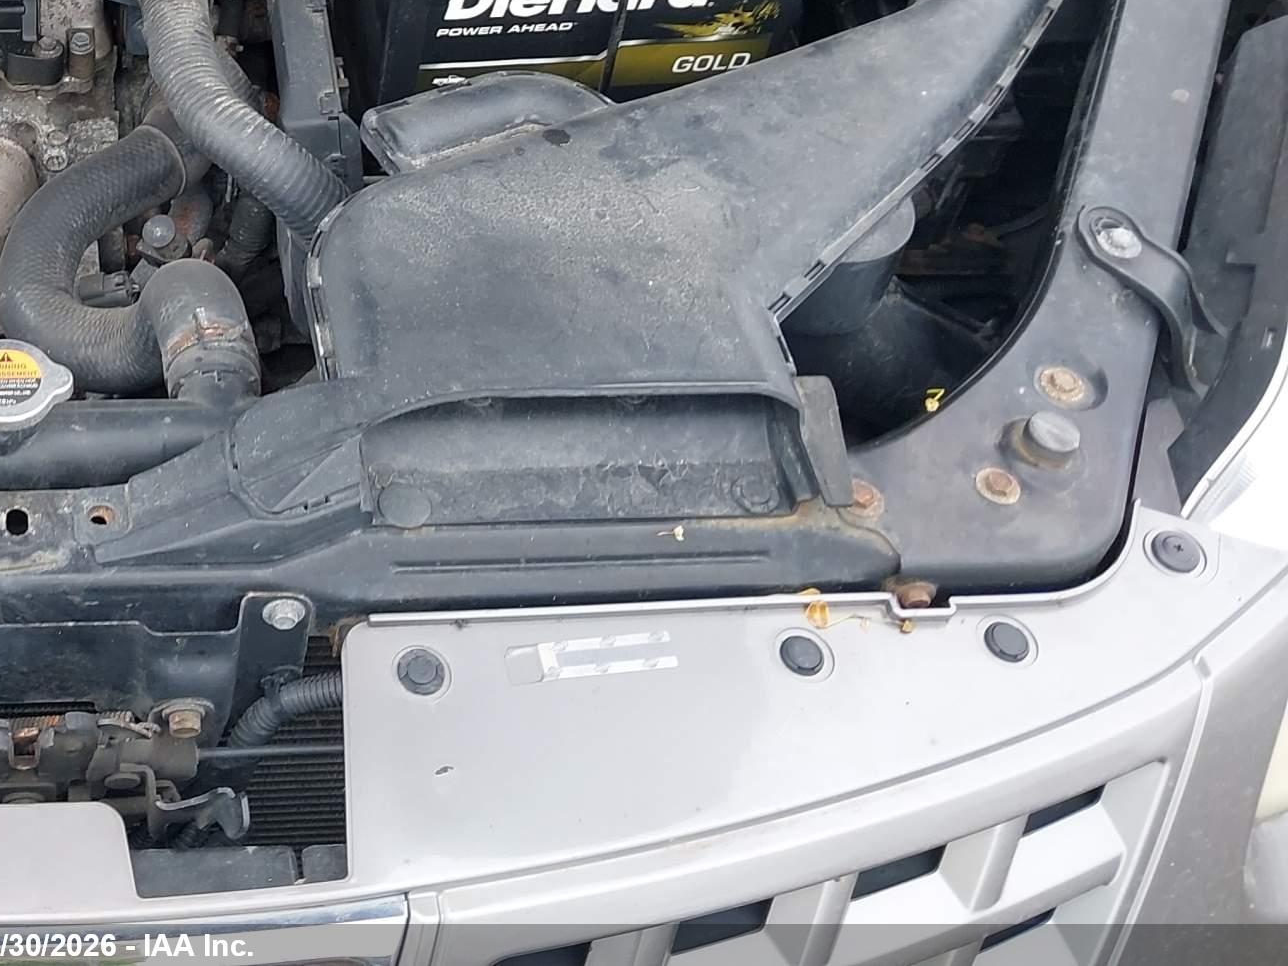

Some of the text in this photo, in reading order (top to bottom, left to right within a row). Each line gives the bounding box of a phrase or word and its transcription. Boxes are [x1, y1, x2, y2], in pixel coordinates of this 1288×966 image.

[436, 22, 574, 37] POWER AHEAD
[671, 52, 751, 74] GOLD
